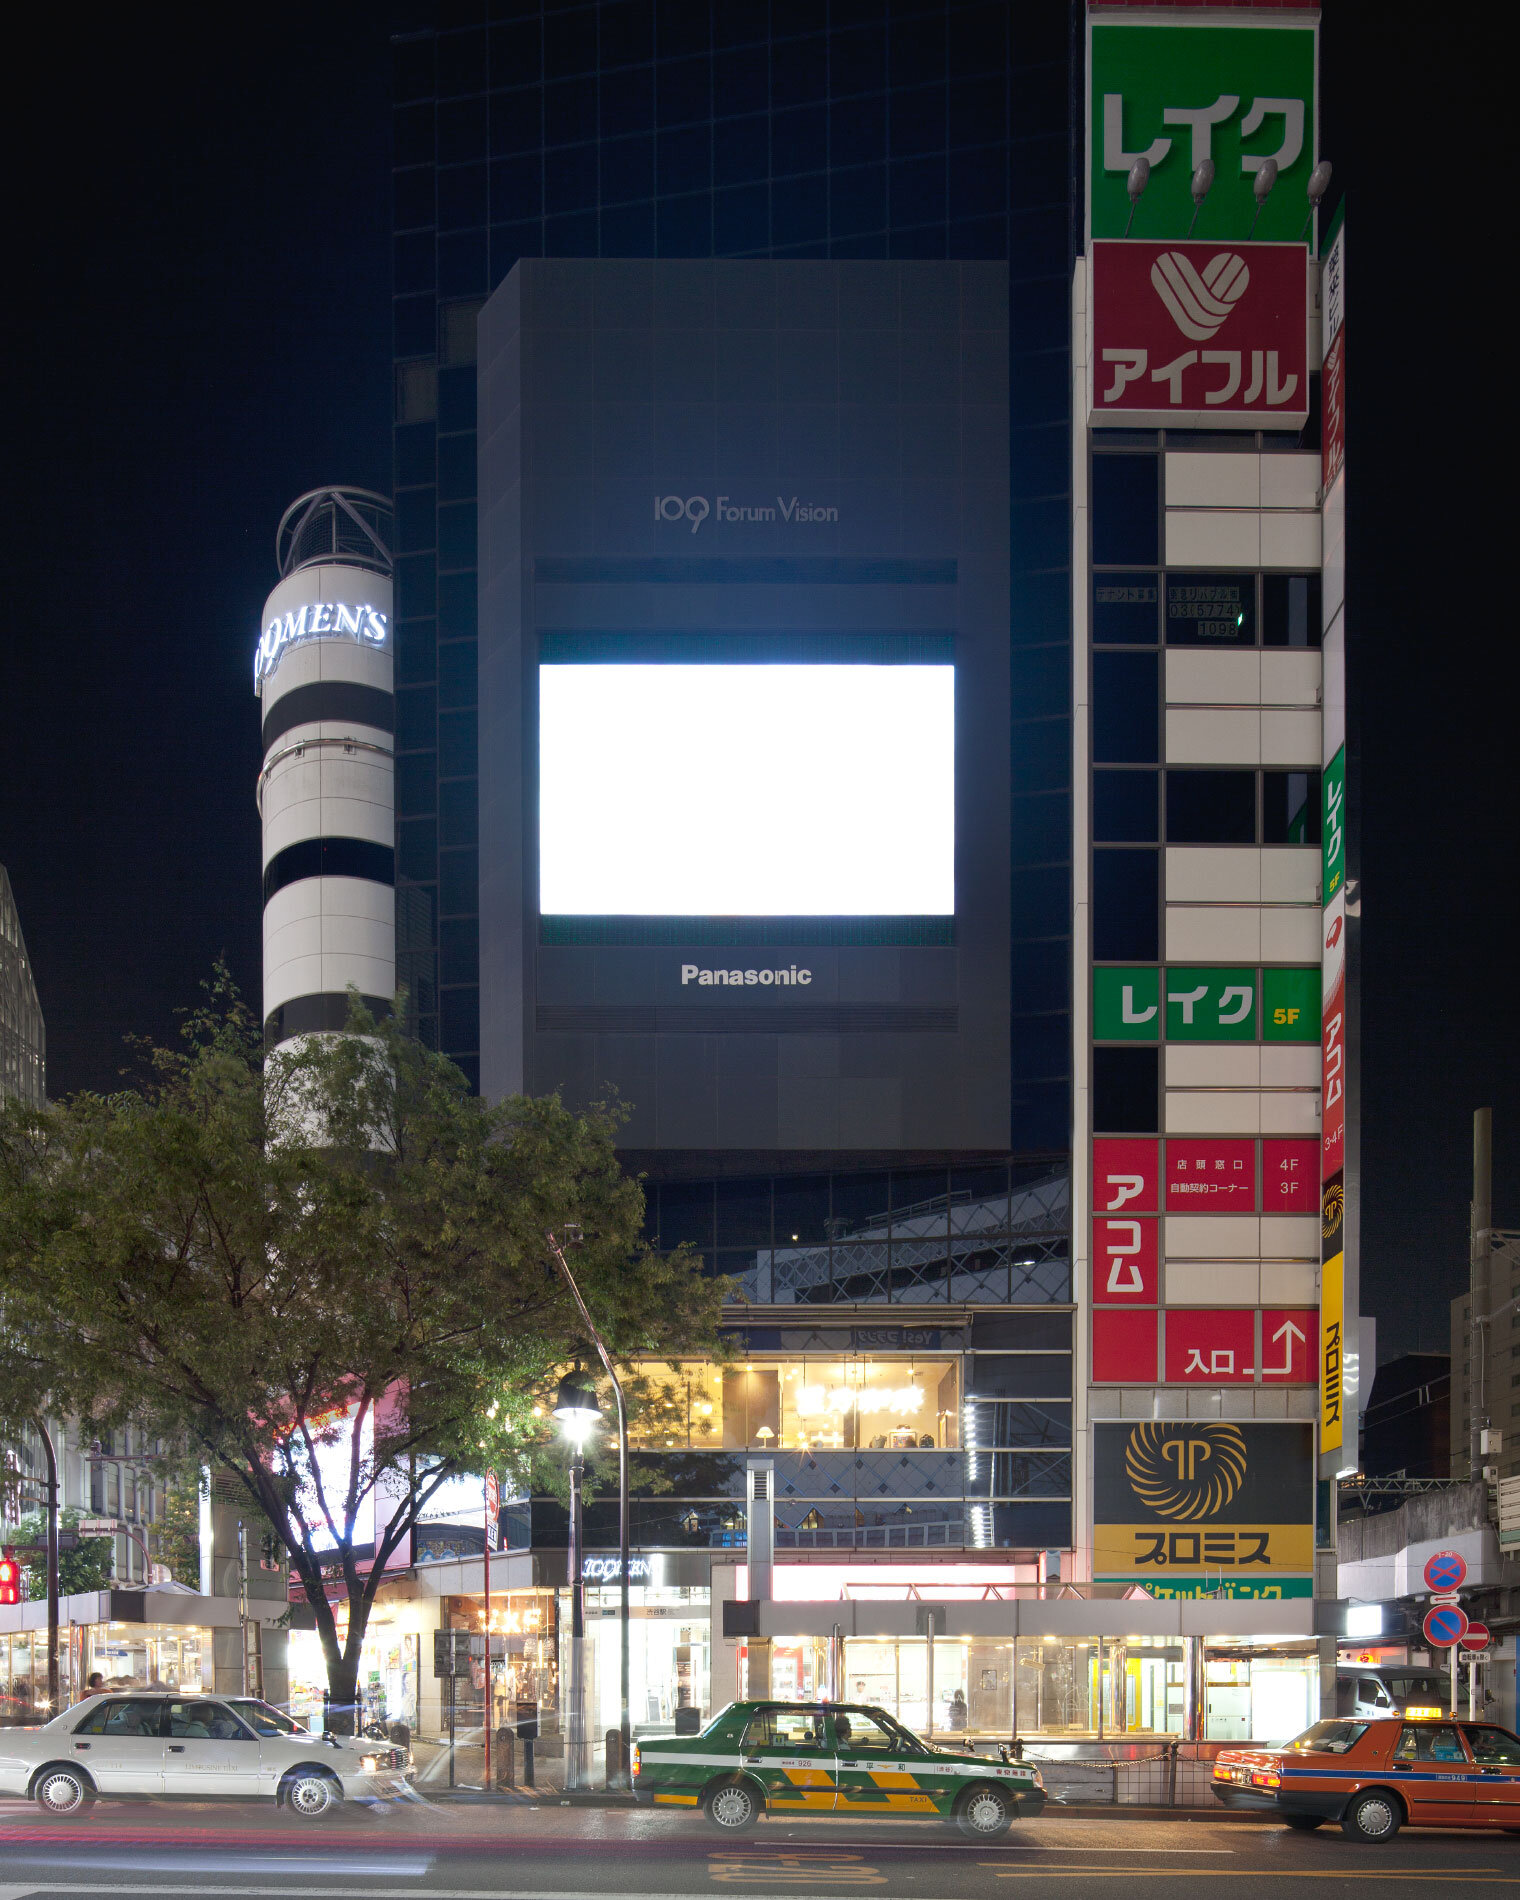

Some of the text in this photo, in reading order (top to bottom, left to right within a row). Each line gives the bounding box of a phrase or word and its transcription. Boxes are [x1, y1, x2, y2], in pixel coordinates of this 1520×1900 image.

[1103, 93, 1305, 172] レイク
[1102, 347, 1299, 405] アイフル
[654, 495, 839, 534] 109 Forum Vision
[1200, 621, 1238, 636] 1098
[1326, 780, 1343, 869] レイク
[1329, 870, 1341, 893] 5F
[681, 964, 812, 986] Panasonic
[1122, 985, 1300, 1025] レイク 5F
[1325, 1012, 1342, 1111] アコム
[1280, 1158, 1299, 1171] 4F
[1170, 1182, 1299, 1194] 自動契約コーナー 3F
[1106, 1174, 1145, 1293] アコム
[1184, 1349, 1235, 1375] 入口
[1325, 1320, 1341, 1427] プロミス
[1134, 1531, 1271, 1565] プロミス
[798, 1760, 812, 1768] 926
